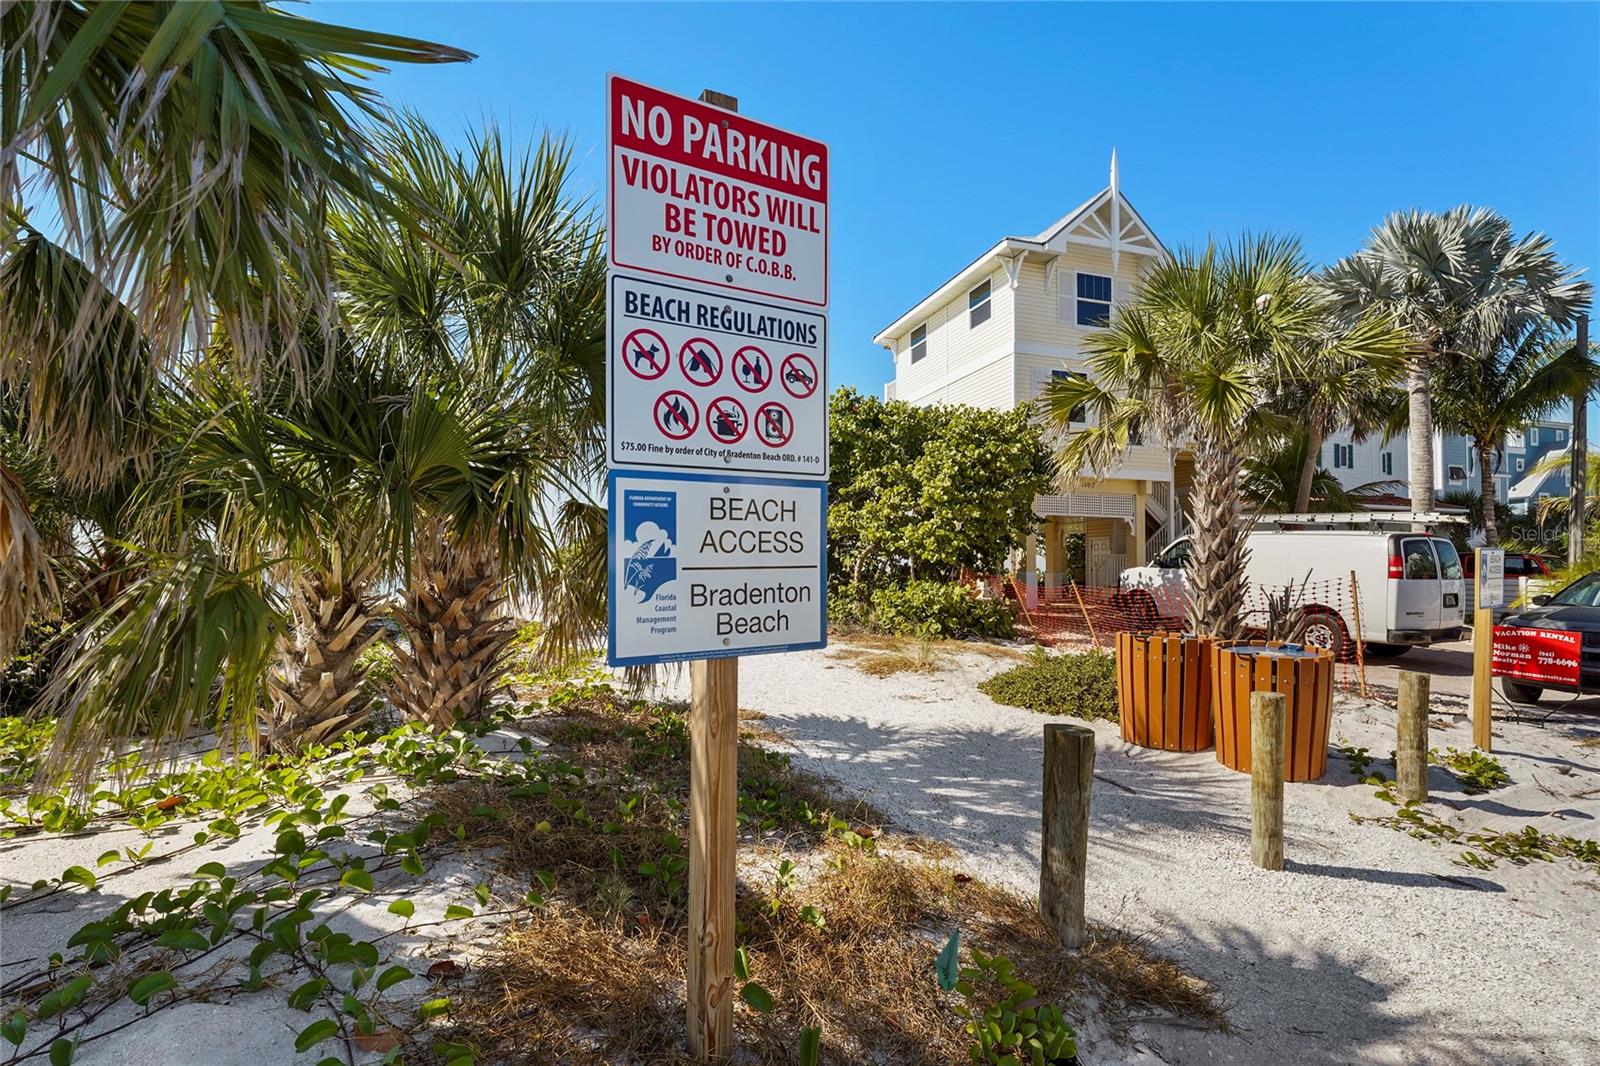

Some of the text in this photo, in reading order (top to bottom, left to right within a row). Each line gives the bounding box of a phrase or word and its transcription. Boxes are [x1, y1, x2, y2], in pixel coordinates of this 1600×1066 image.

[621, 95, 821, 190] NO PARKING
[621, 154, 820, 233] VIOLATORS WILL
[665, 203, 787, 257] BE TOWED
[652, 235, 796, 281] BY ORDER OF C.O.B.B.
[625, 291, 817, 344] BEACH REGULATIONS
[621, 442, 647, 452] $75.00
[648, 443, 664, 453] Fine
[665, 446, 674, 455] by
[675, 446, 694, 456] order
[695, 447, 703, 456] of
[704, 448, 717, 459] City
[718, 449, 726, 457] of
[726, 450, 761, 460] Bradenton
[762, 452, 781, 461] Beach
[709, 496, 796, 522] BEACH
[699, 530, 804, 554] ACCESS
[656, 593, 677, 602] Florida
[691, 582, 811, 607] Bradenton
[655, 603, 677, 613] Coastal
[636, 614, 677, 625] Management
[716, 609, 789, 636] Beach
[650, 625, 677, 635] Program
[1540, 632, 1576, 643] RENTAL
[1493, 643, 1516, 651] Mike
[1493, 650, 1532, 659] Norman
[1492, 656, 1518, 664] Realty
[1538, 657, 1578, 668] 778-6696
